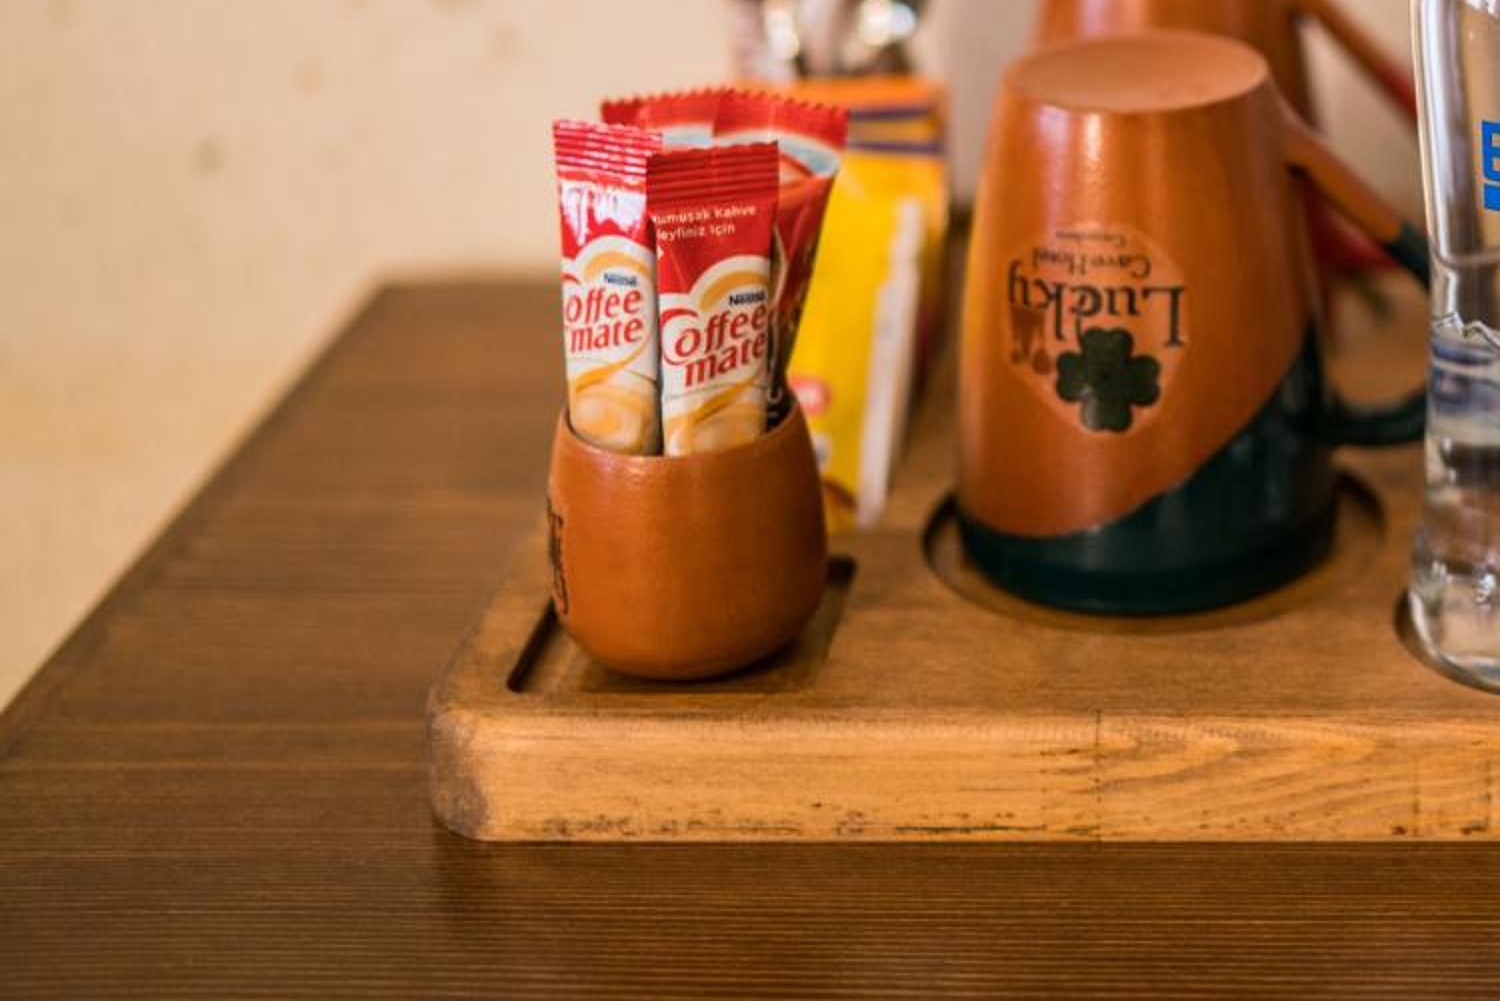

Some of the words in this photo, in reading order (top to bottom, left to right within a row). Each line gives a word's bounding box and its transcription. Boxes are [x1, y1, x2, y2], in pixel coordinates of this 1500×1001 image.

[1008, 259, 1185, 346] Lucky
[571, 318, 644, 353] mate
[658, 304, 767, 366] Coffee
[685, 333, 767, 387] mate
